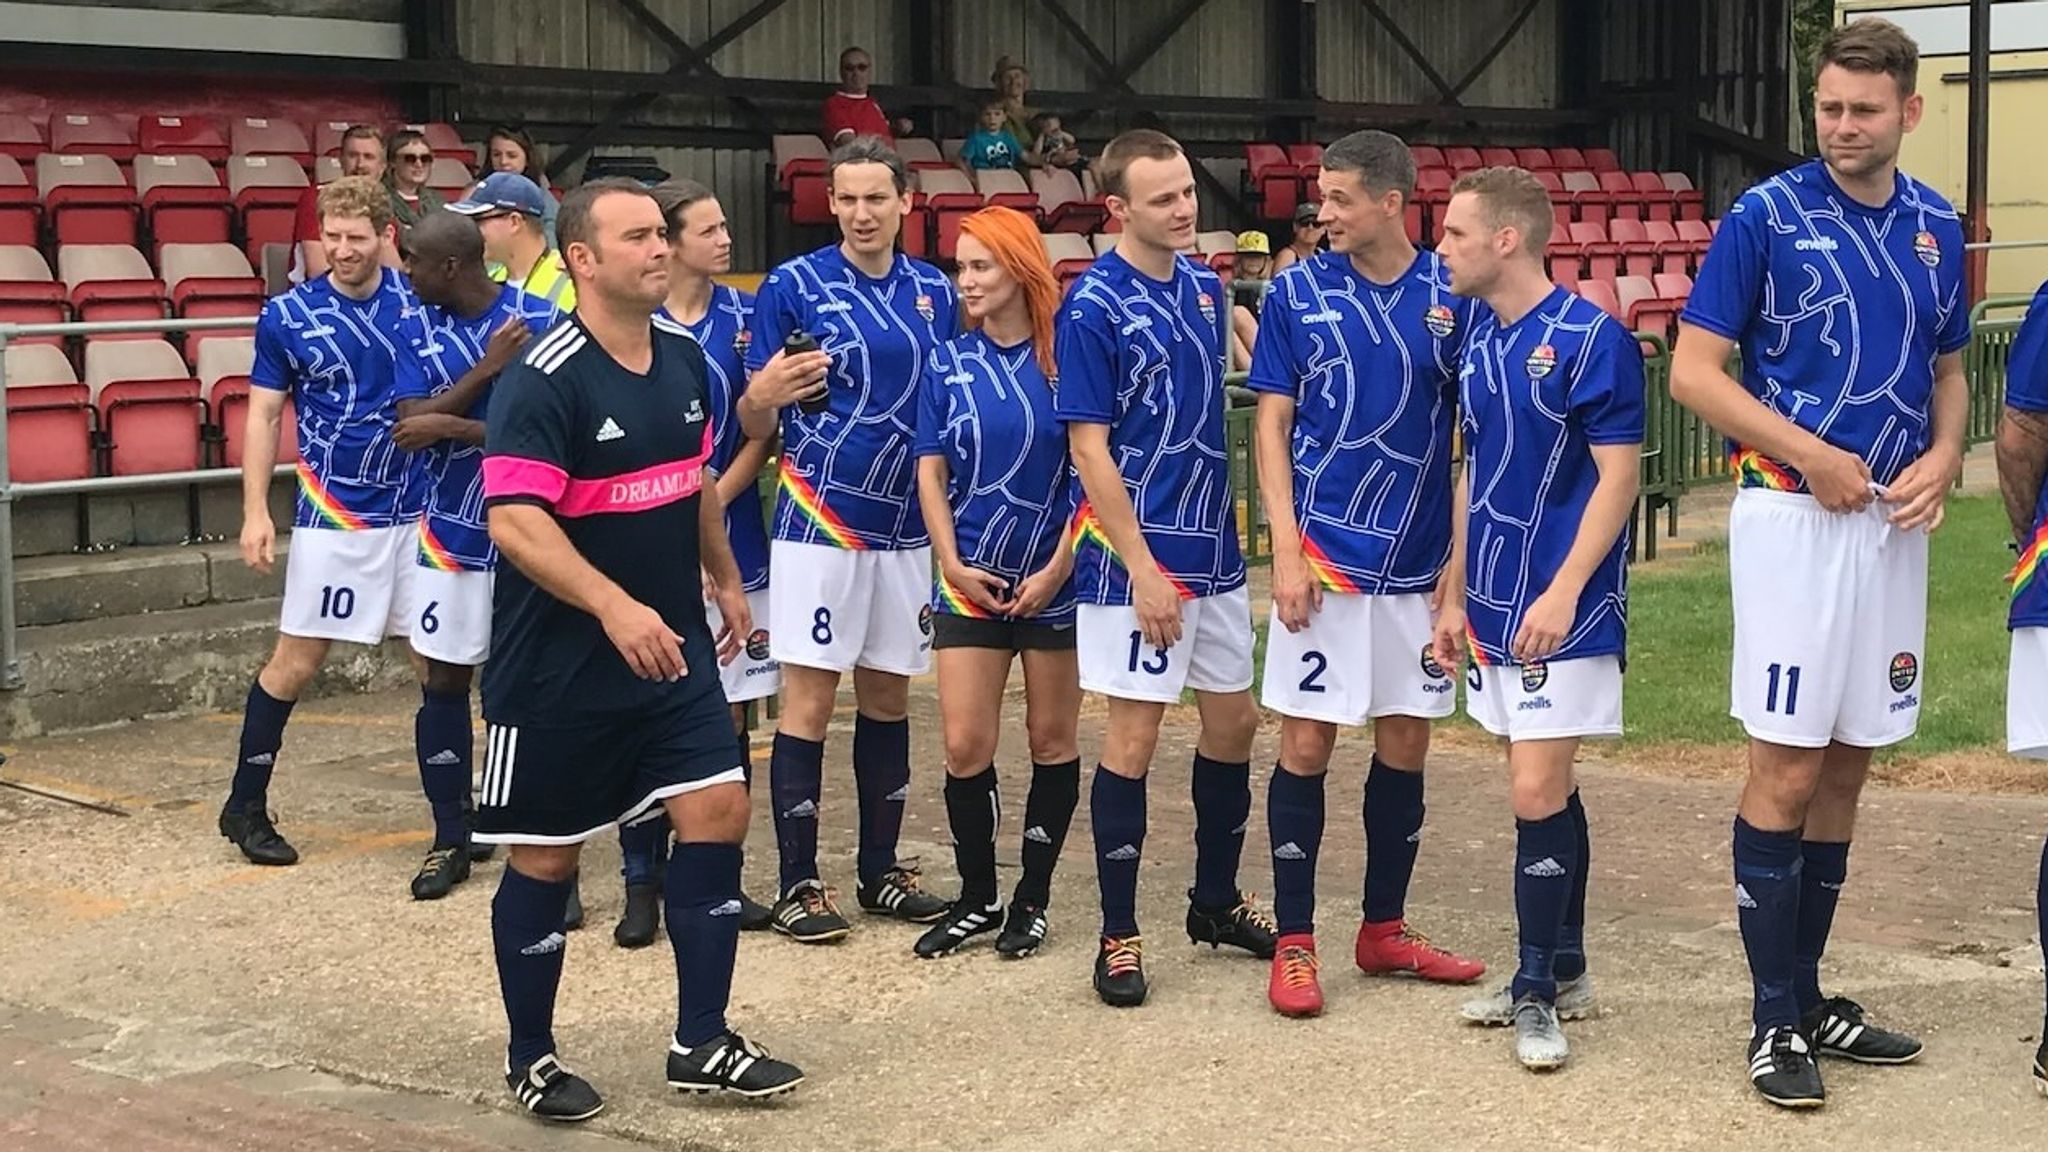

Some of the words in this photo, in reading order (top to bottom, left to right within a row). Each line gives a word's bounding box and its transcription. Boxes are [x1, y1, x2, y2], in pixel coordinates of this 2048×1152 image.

[320, 585, 357, 620] 10
[421, 600, 440, 635] 6
[812, 606, 833, 646] 8
[1129, 630, 1169, 675] 13
[1299, 650, 1328, 693] 2
[1766, 662, 1801, 716] 11
